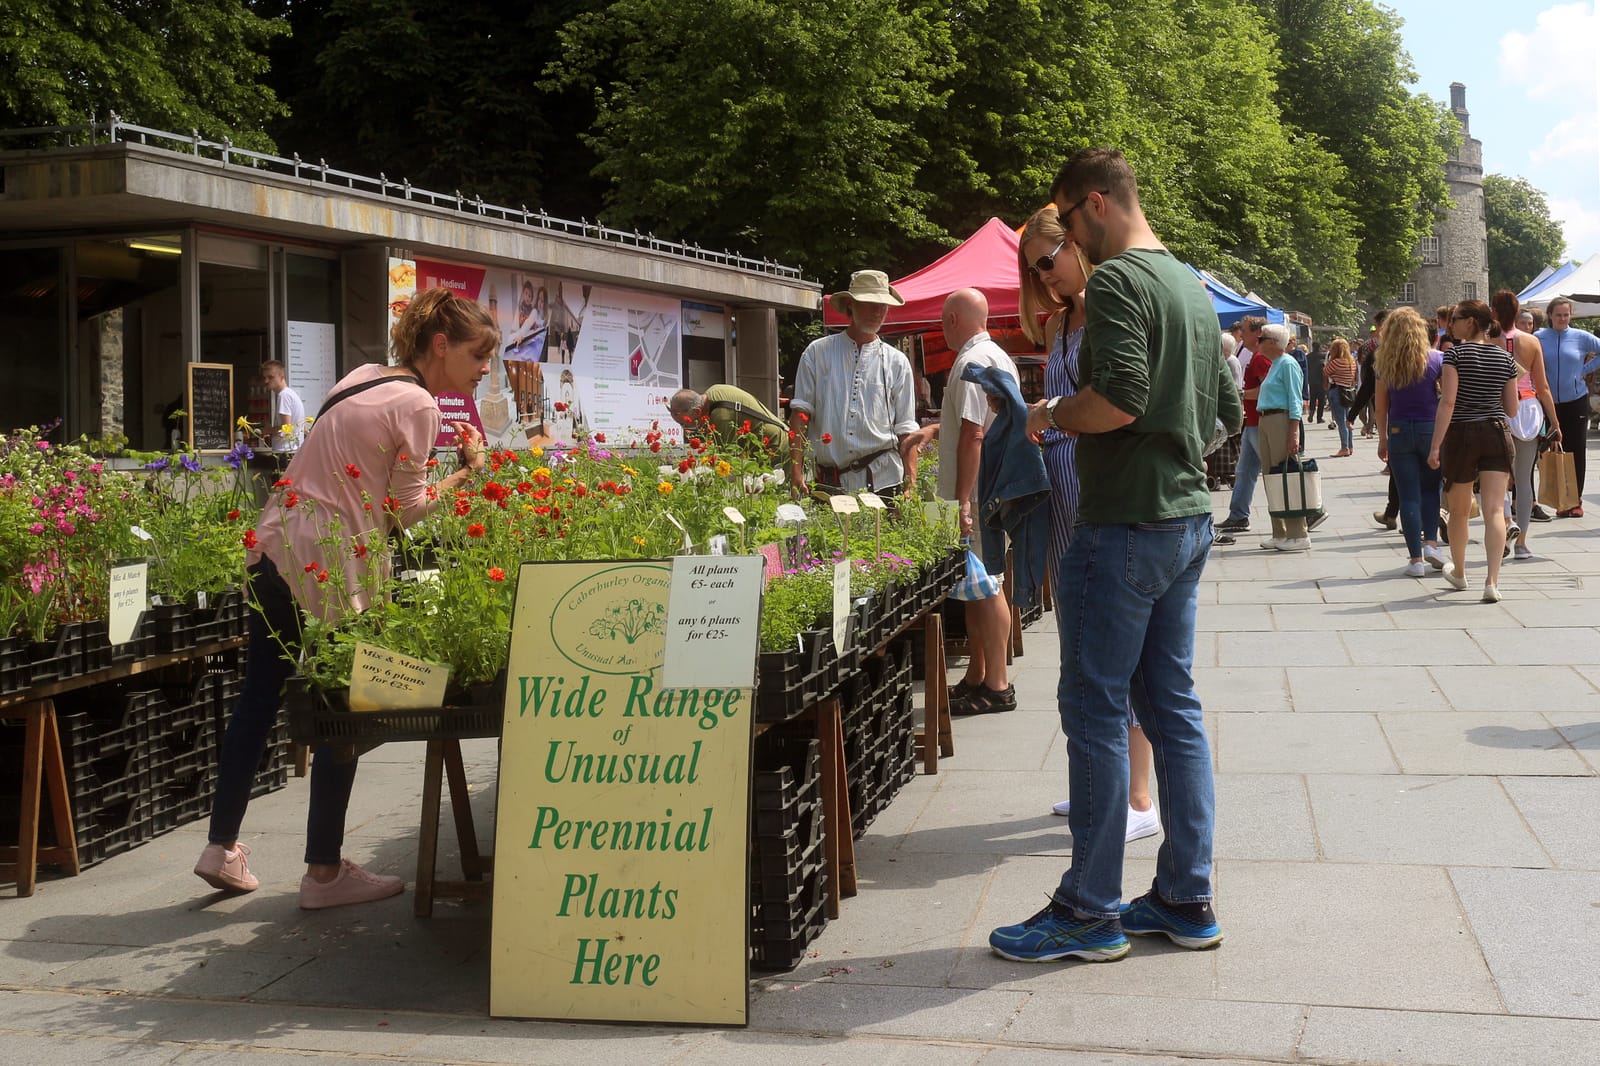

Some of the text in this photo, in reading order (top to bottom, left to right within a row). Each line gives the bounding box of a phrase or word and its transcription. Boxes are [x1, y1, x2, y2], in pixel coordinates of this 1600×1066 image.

[441, 278, 467, 290] Medieval
[440, 396, 464, 406] minutes
[689, 565, 739, 576] All plants
[691, 579, 734, 589] €5- each
[678, 616, 741, 627] any 6 plants
[685, 629, 729, 642] for €25-
[361, 648, 384, 660] Mix
[398, 659, 432, 675] Match
[362, 663, 383, 674] any
[392, 671, 426, 687] plants
[369, 674, 389, 685] for
[518, 675, 741, 731] Wide Range
[612, 724, 634, 746] of
[544, 740, 703, 784] Unusual
[528, 806, 714, 851] Perennial
[556, 873, 679, 920] Plants
[569, 938, 661, 986] Here
